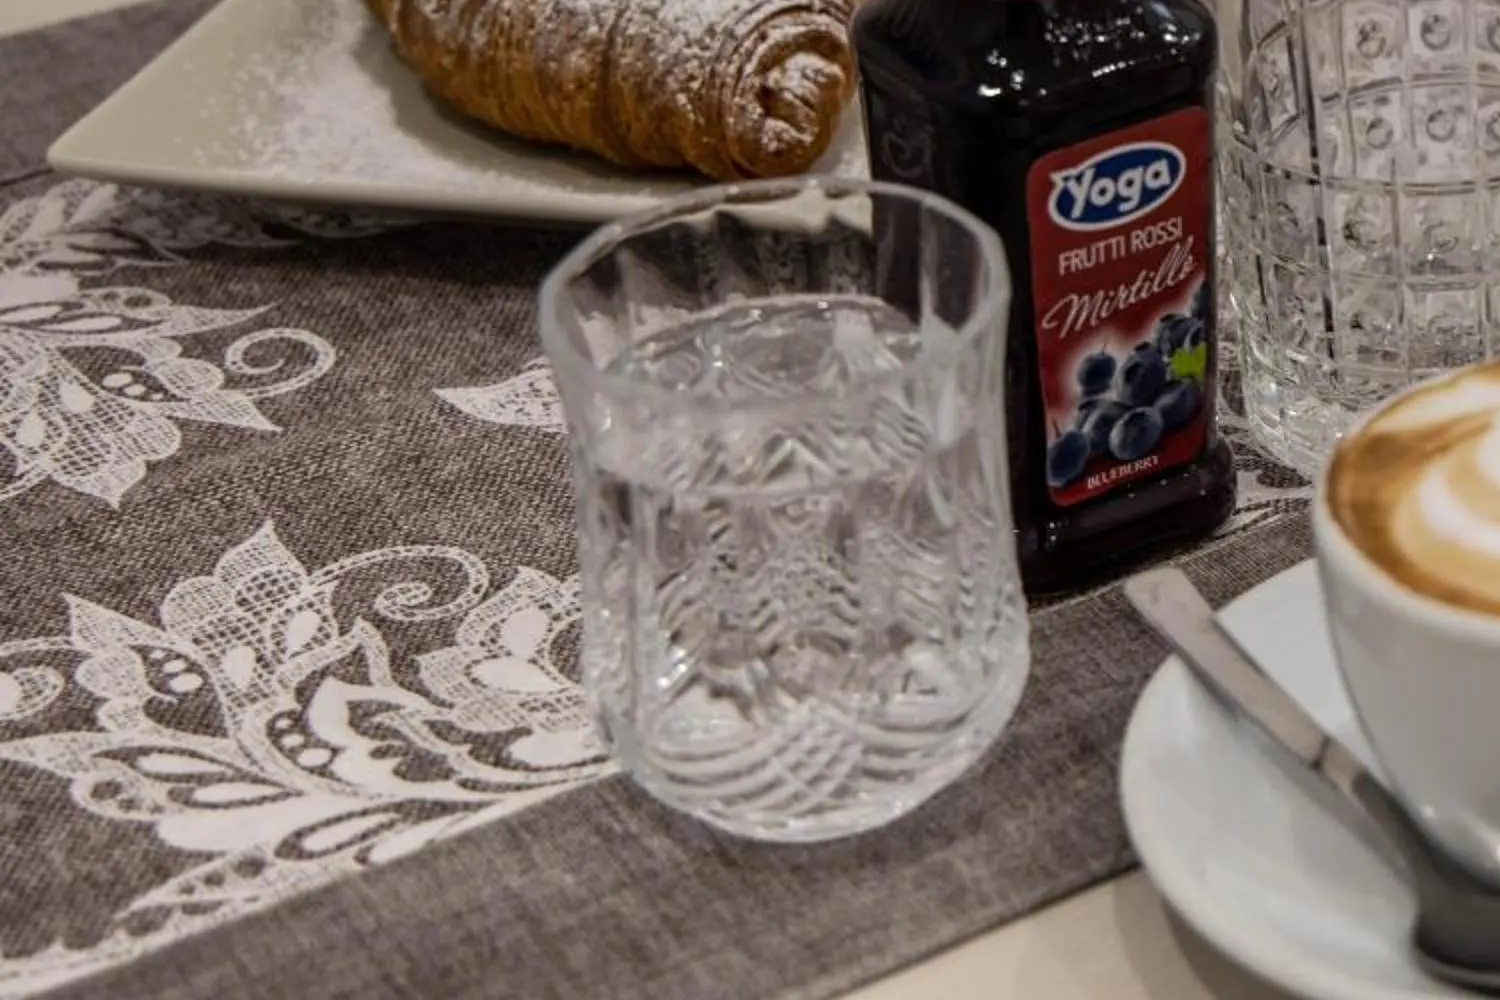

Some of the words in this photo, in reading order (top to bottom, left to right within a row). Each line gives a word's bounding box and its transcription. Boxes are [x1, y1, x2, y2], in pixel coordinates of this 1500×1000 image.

[1064, 157, 1172, 220] Yoga
[1058, 235, 1126, 277] FRUTTI
[1130, 216, 1184, 251] ROSSI
